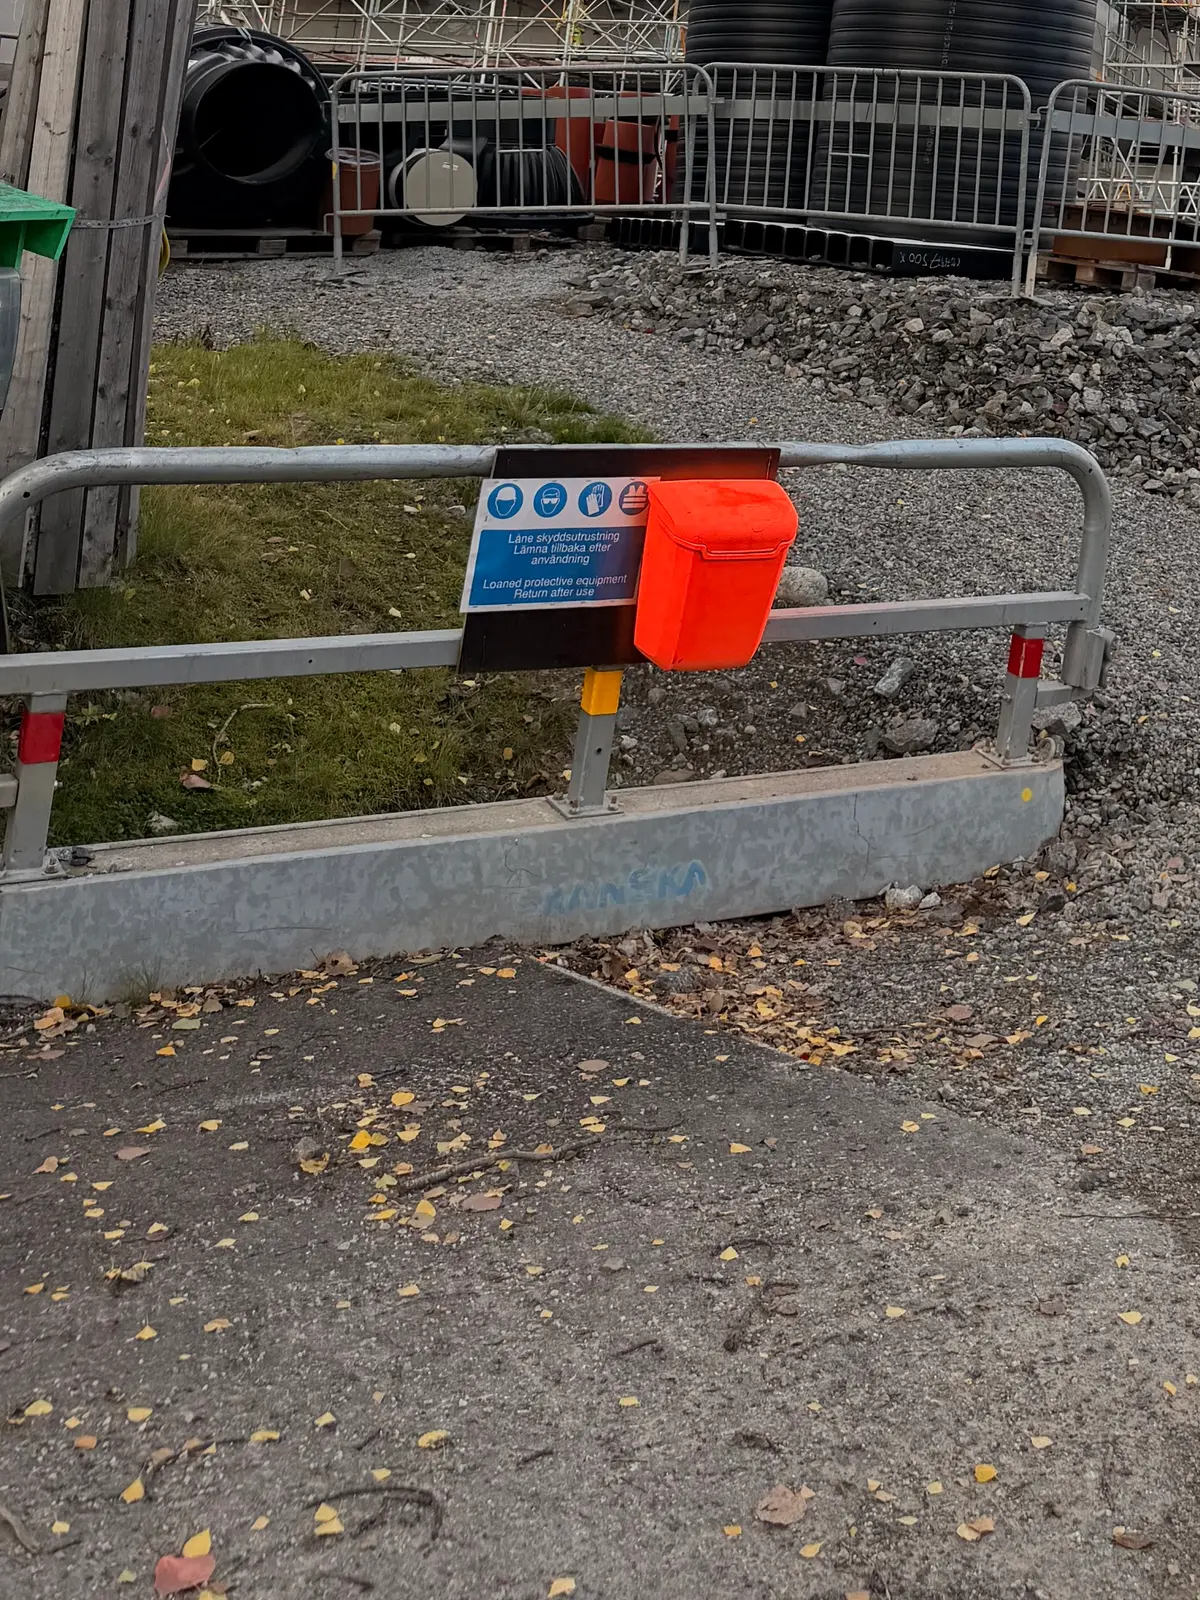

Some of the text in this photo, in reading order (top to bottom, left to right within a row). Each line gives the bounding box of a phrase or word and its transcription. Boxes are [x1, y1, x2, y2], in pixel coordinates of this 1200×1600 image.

[508, 530, 620, 545] Låne skyddsutrustning
[513, 542, 612, 555] Lämna tillbaka efter
[531, 553, 590, 566] användning
[482, 574, 628, 590] Loaned protective equipment
[513, 586, 595, 599] Return after use
